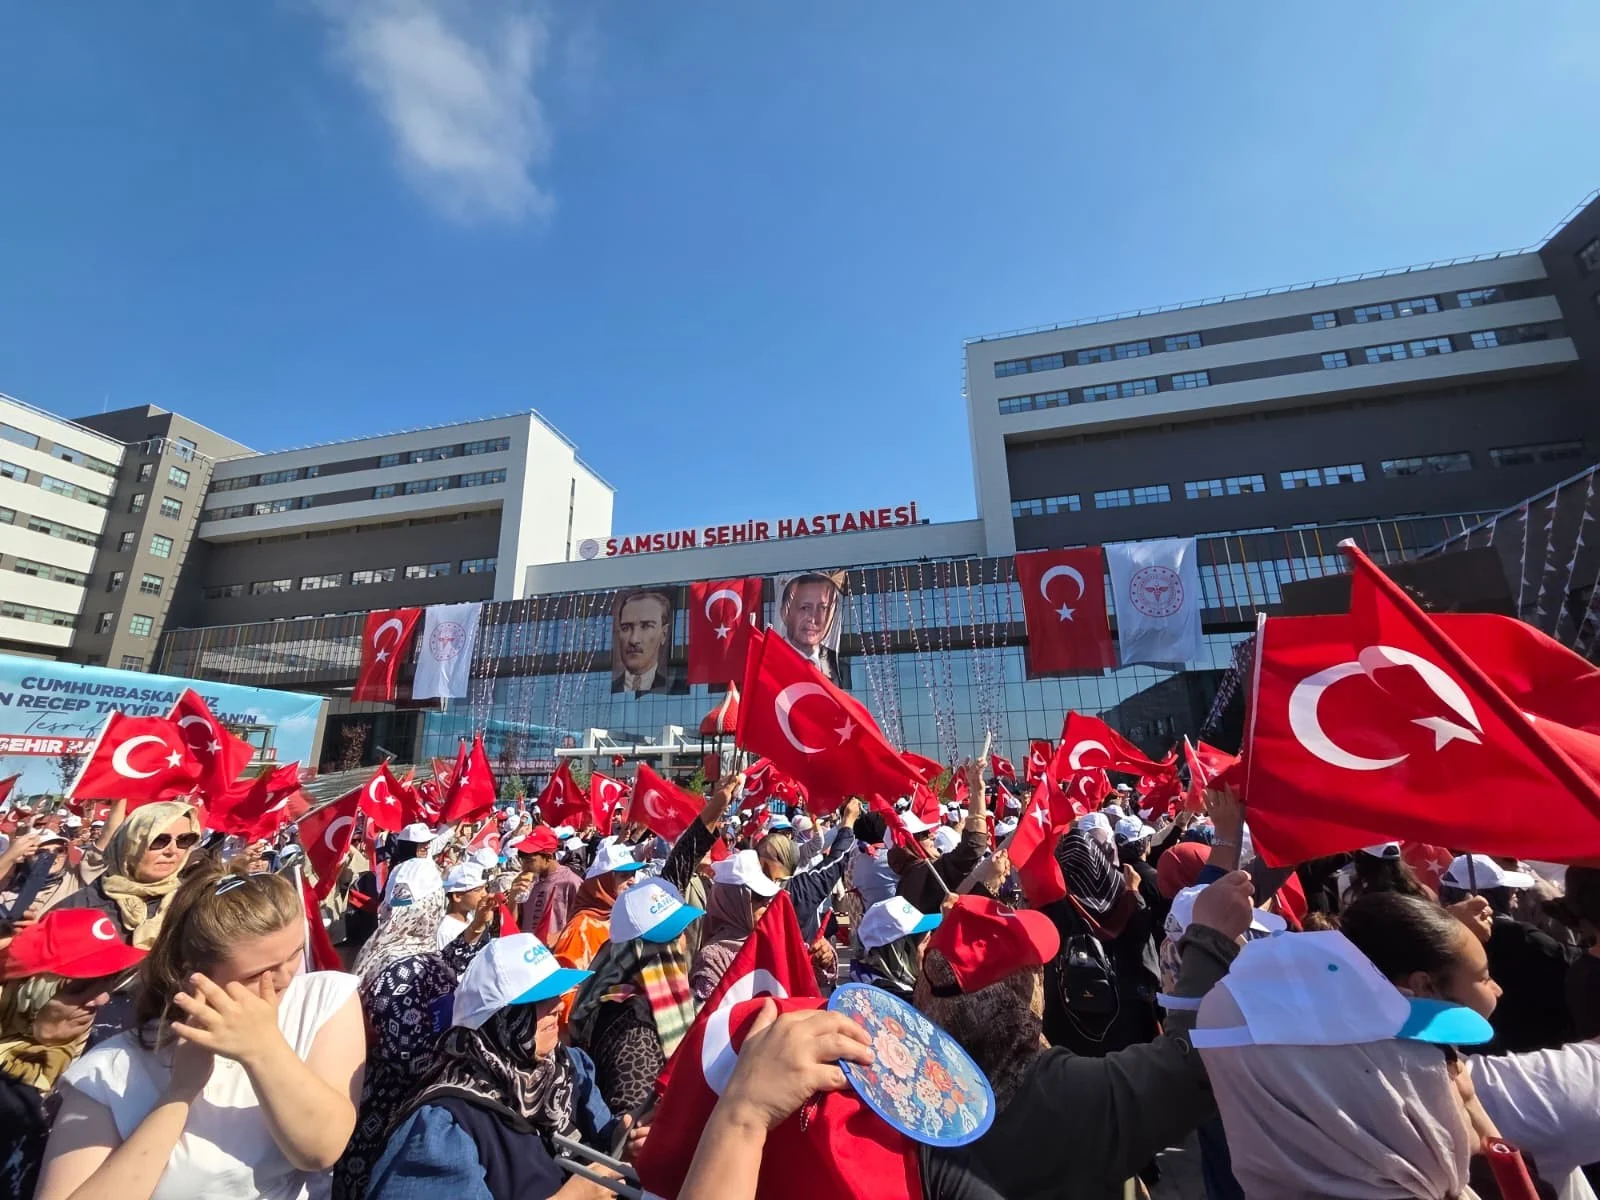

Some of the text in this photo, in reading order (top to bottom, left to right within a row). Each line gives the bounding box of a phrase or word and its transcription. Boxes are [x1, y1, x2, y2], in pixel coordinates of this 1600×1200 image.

[606, 501, 917, 556] SAMSUN ŞEHİR HASTANESİ
[16, 694, 91, 711] RECEP
[21, 676, 219, 707] CUMHURBAŞKAIZ
